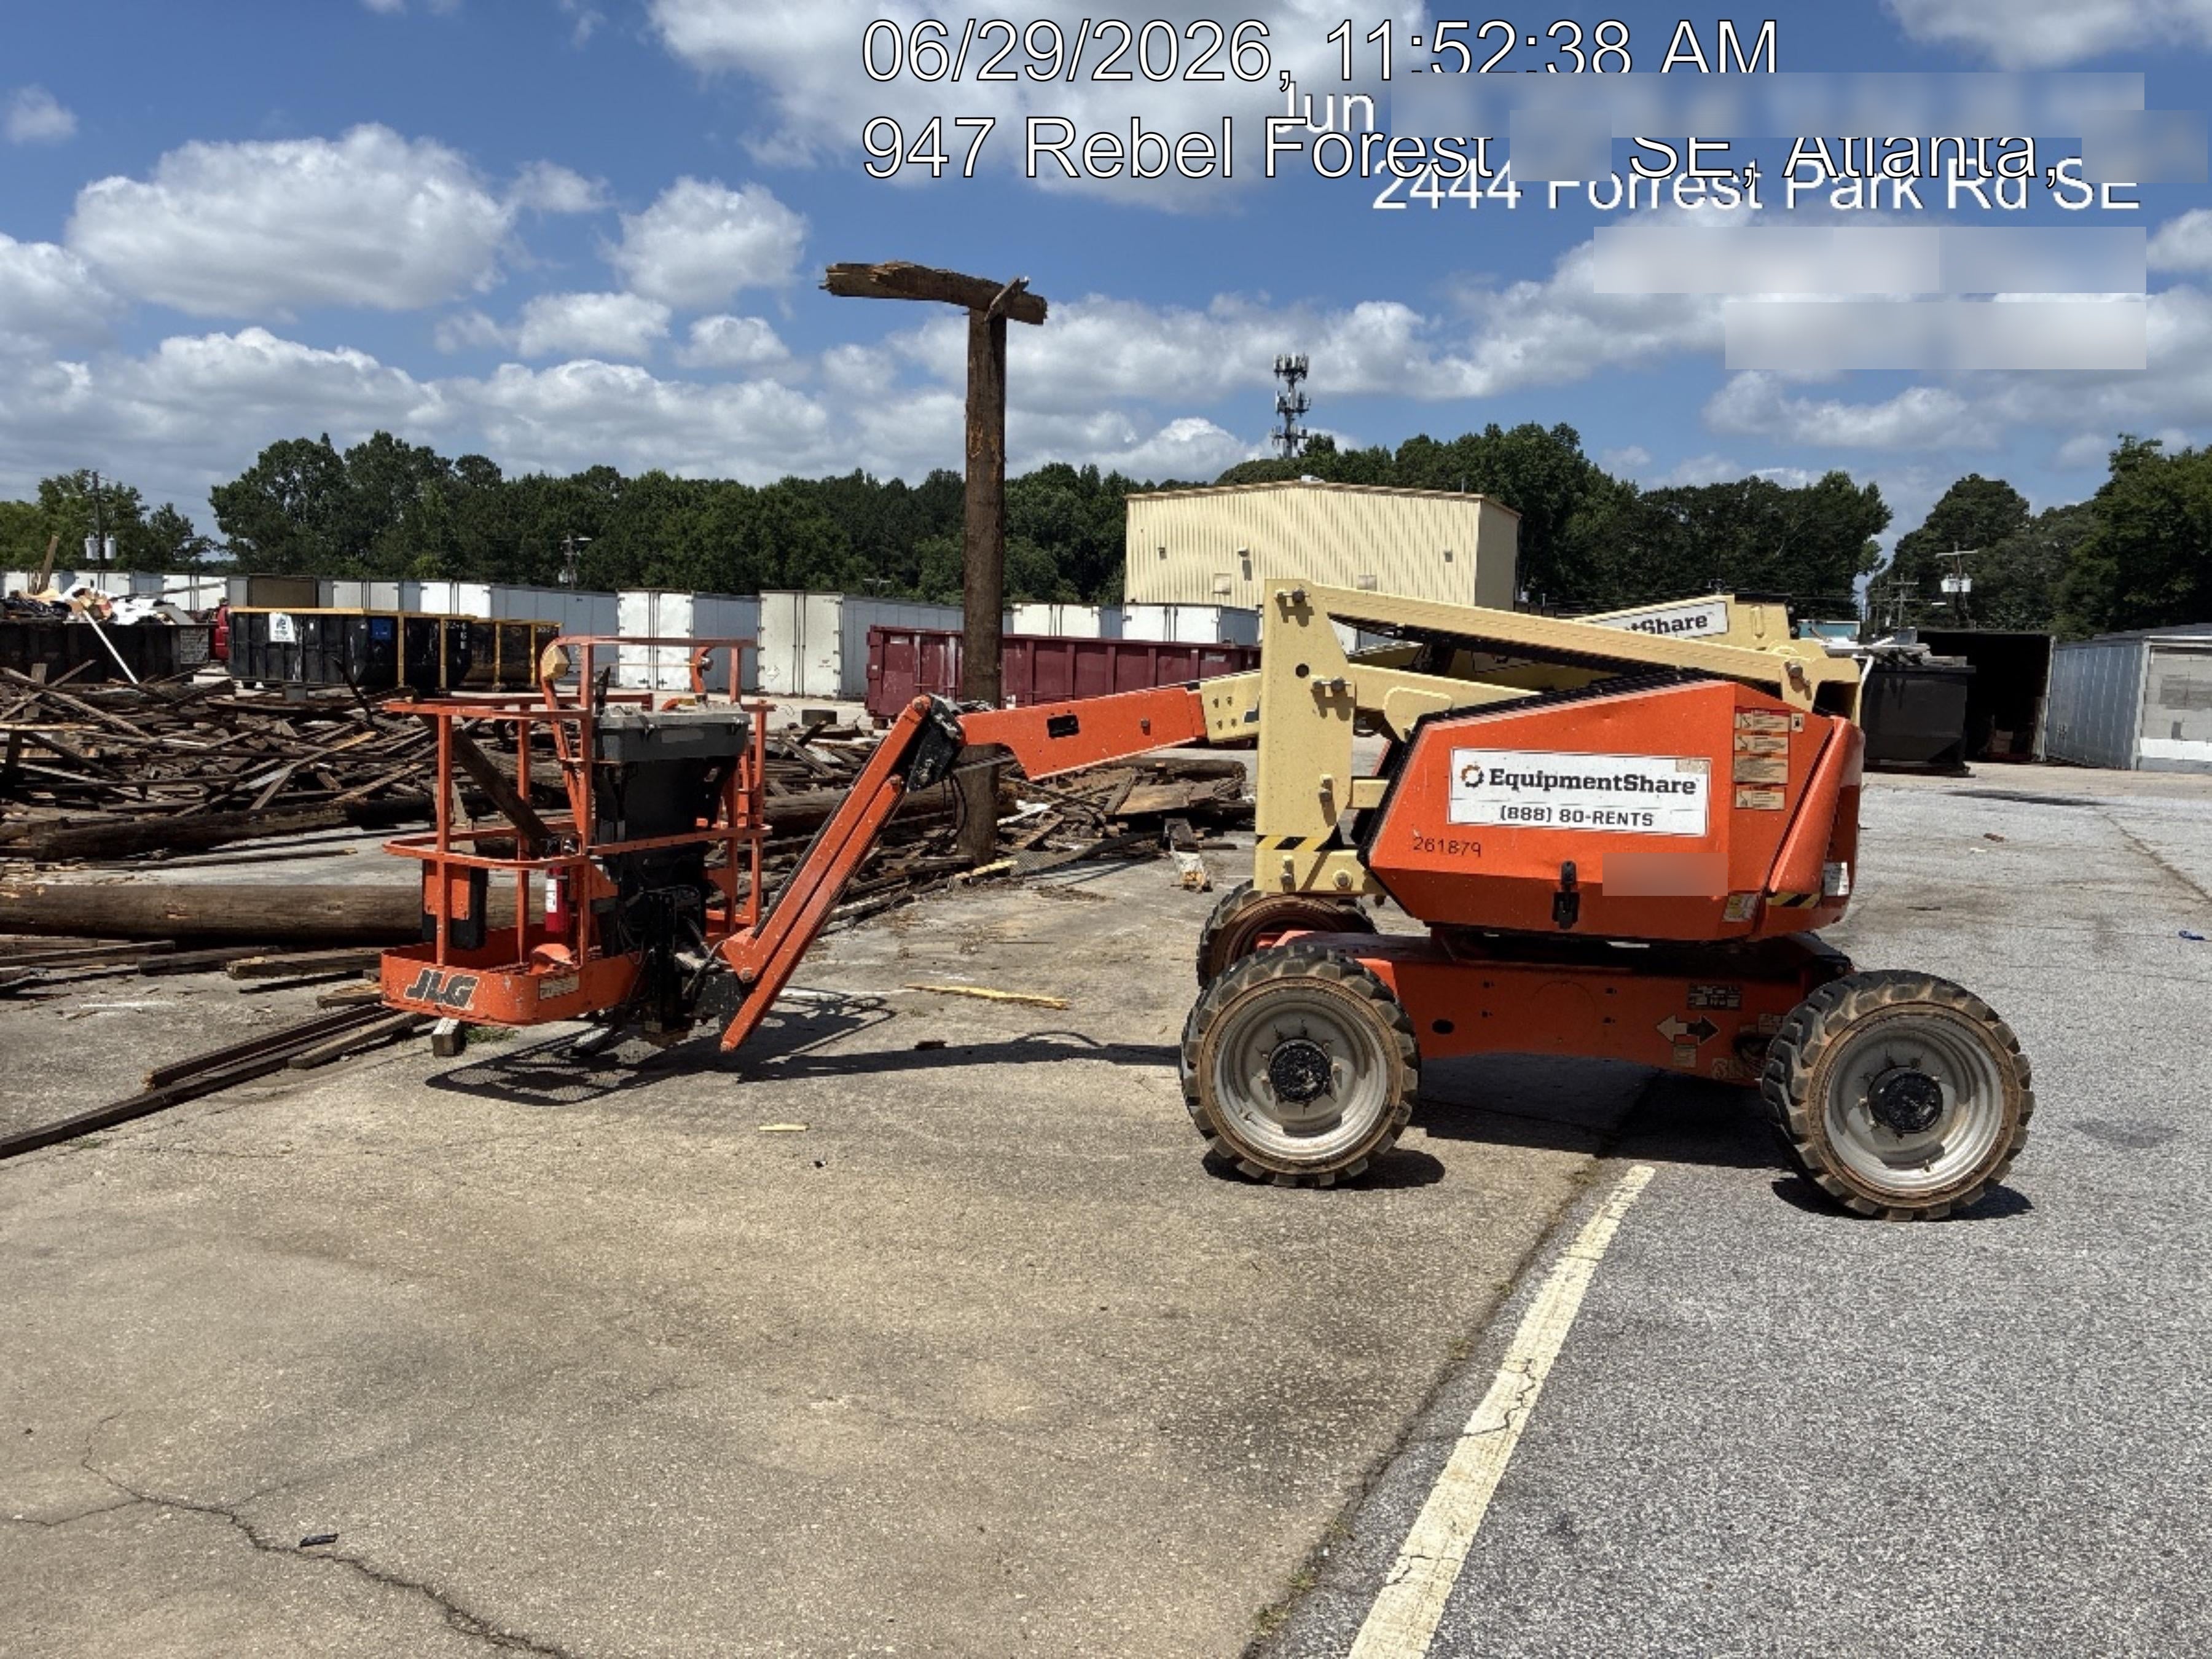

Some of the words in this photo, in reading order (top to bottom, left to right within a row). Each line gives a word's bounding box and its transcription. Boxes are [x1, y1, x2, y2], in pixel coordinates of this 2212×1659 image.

[1489, 767, 1697, 794] EquipmentShare
[1559, 809, 1654, 826] 80-RENTS
[1413, 836, 1481, 858] 261879
[403, 967, 480, 1011] JLG
